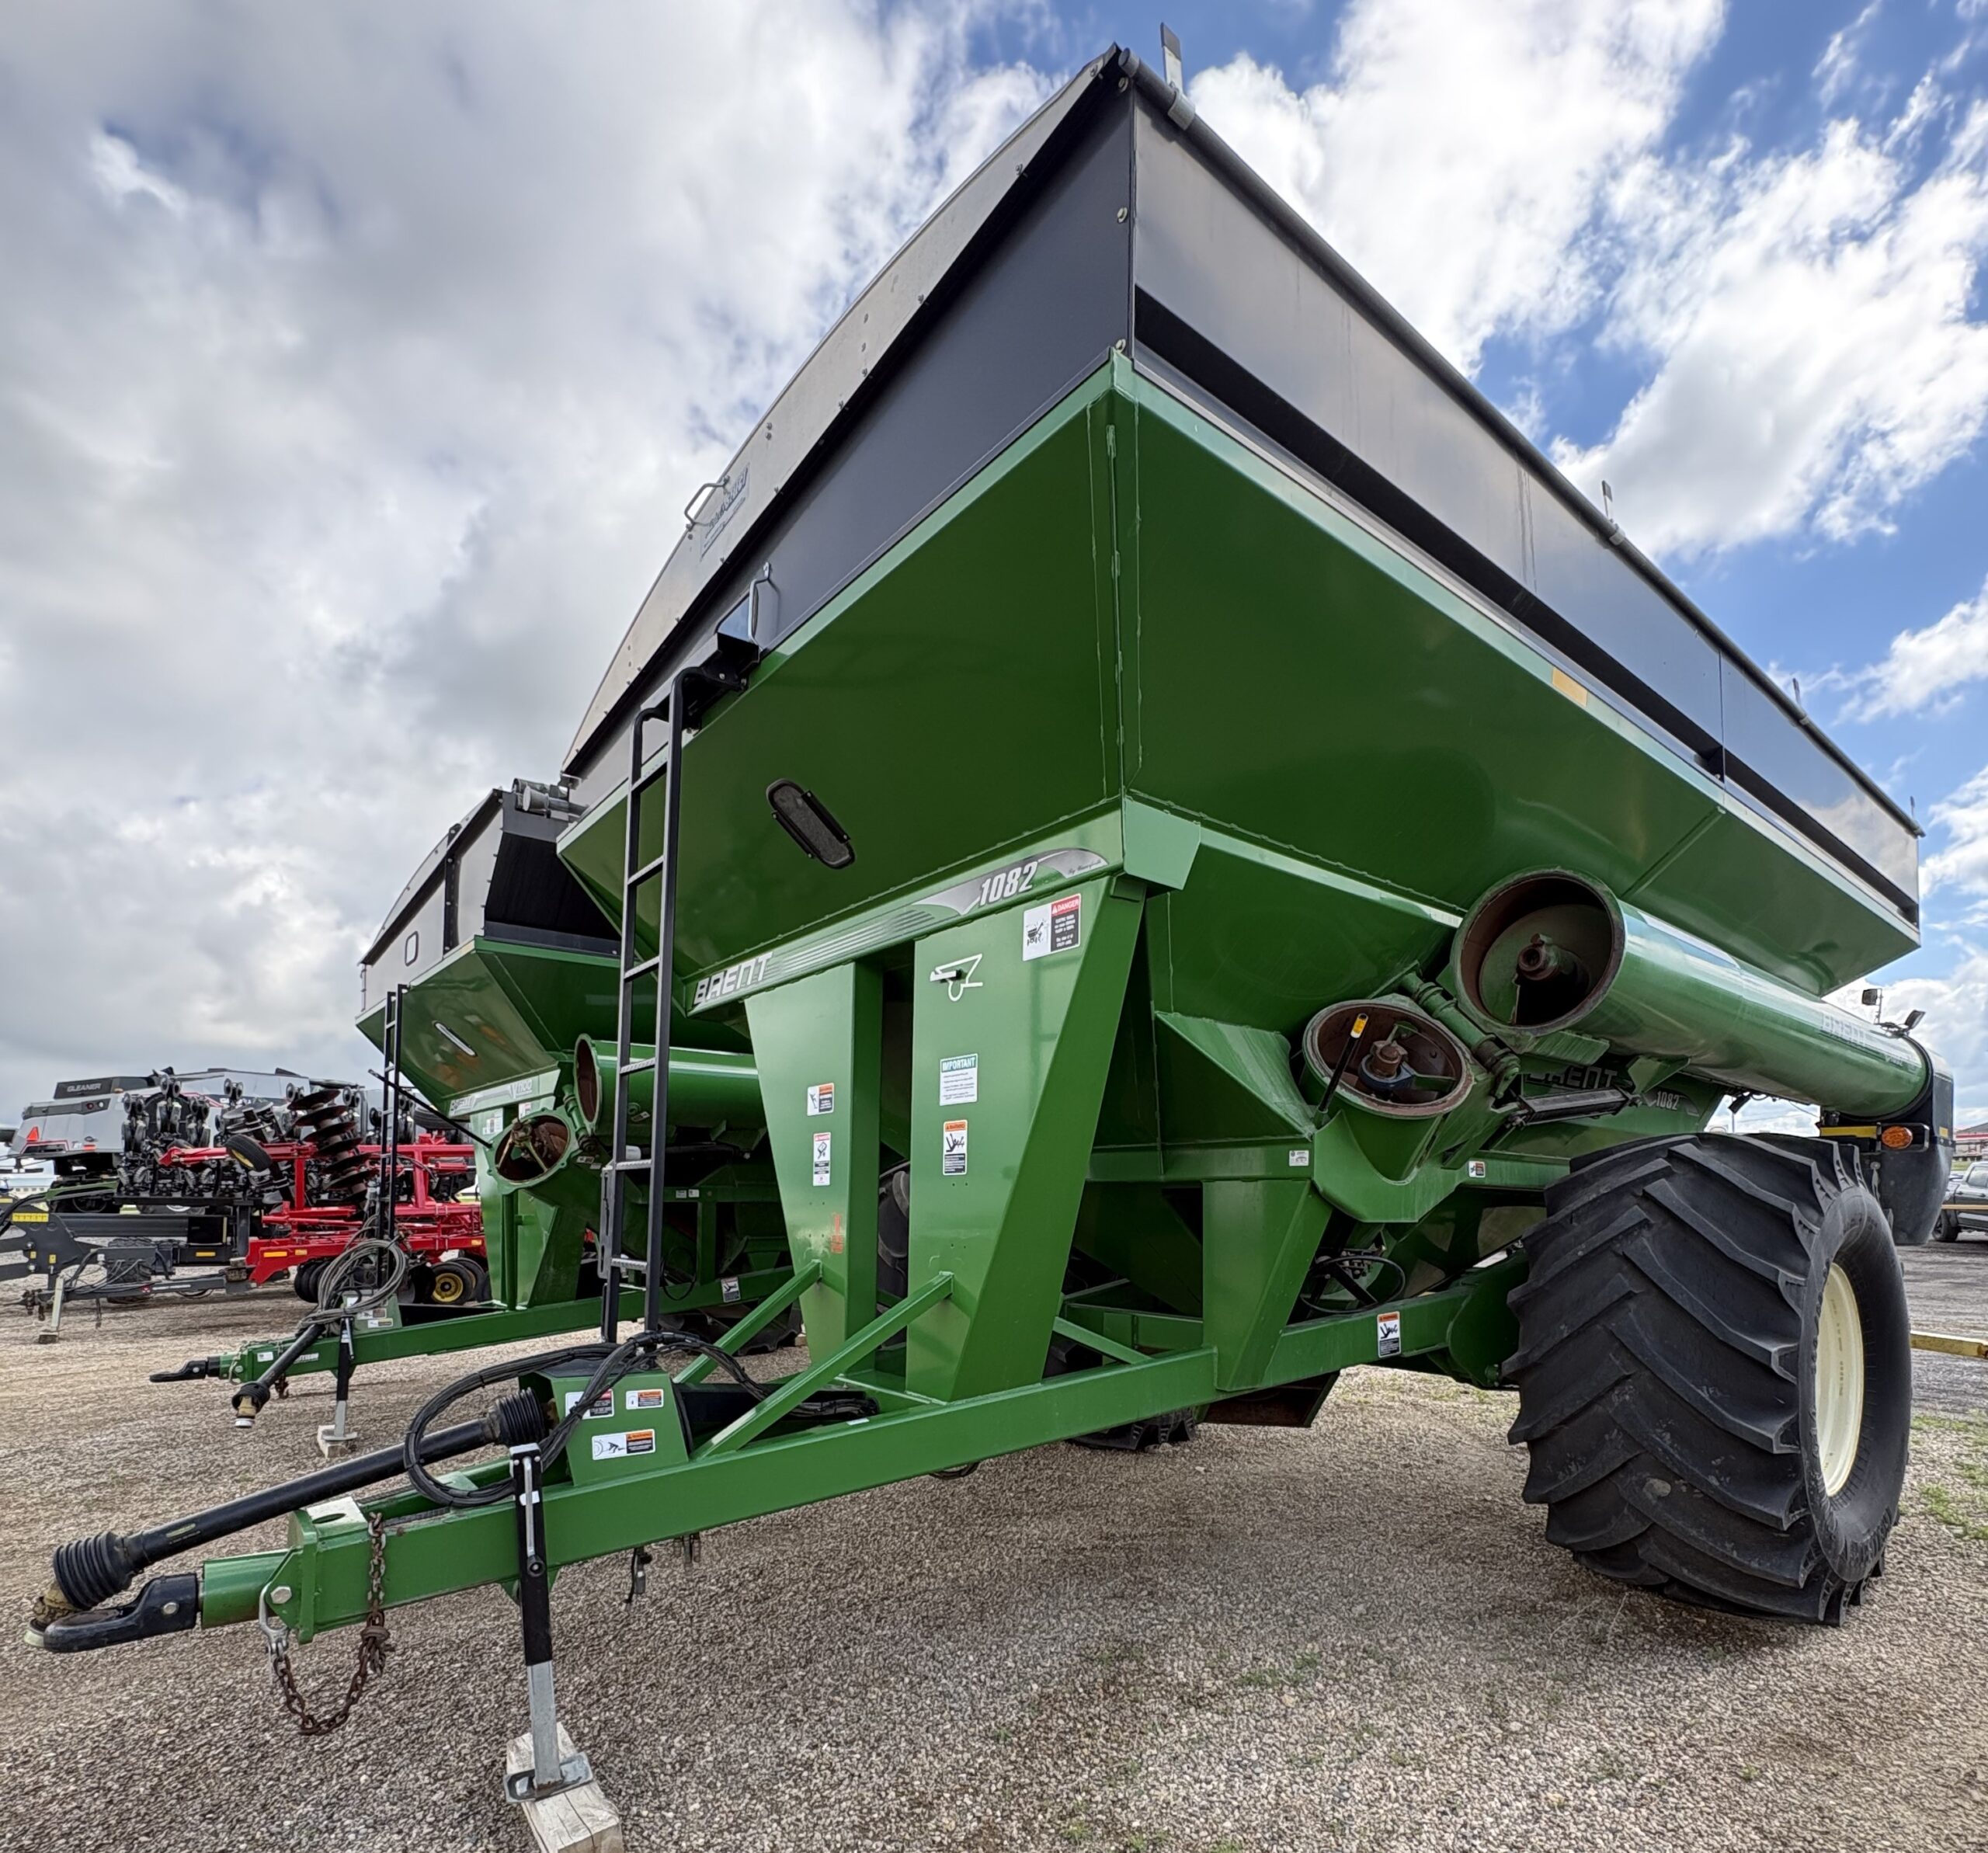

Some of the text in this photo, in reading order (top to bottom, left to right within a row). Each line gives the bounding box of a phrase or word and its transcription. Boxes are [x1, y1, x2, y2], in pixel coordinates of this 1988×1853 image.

[980, 861, 1038, 906] 1082
[1057, 898, 1079, 912] DANGER
[693, 951, 773, 1006] BRENT
[942, 1056, 976, 1072] IMPORTANT
[67, 1083, 101, 1093] GLEANER
[1656, 1090, 1680, 1111] 1082
